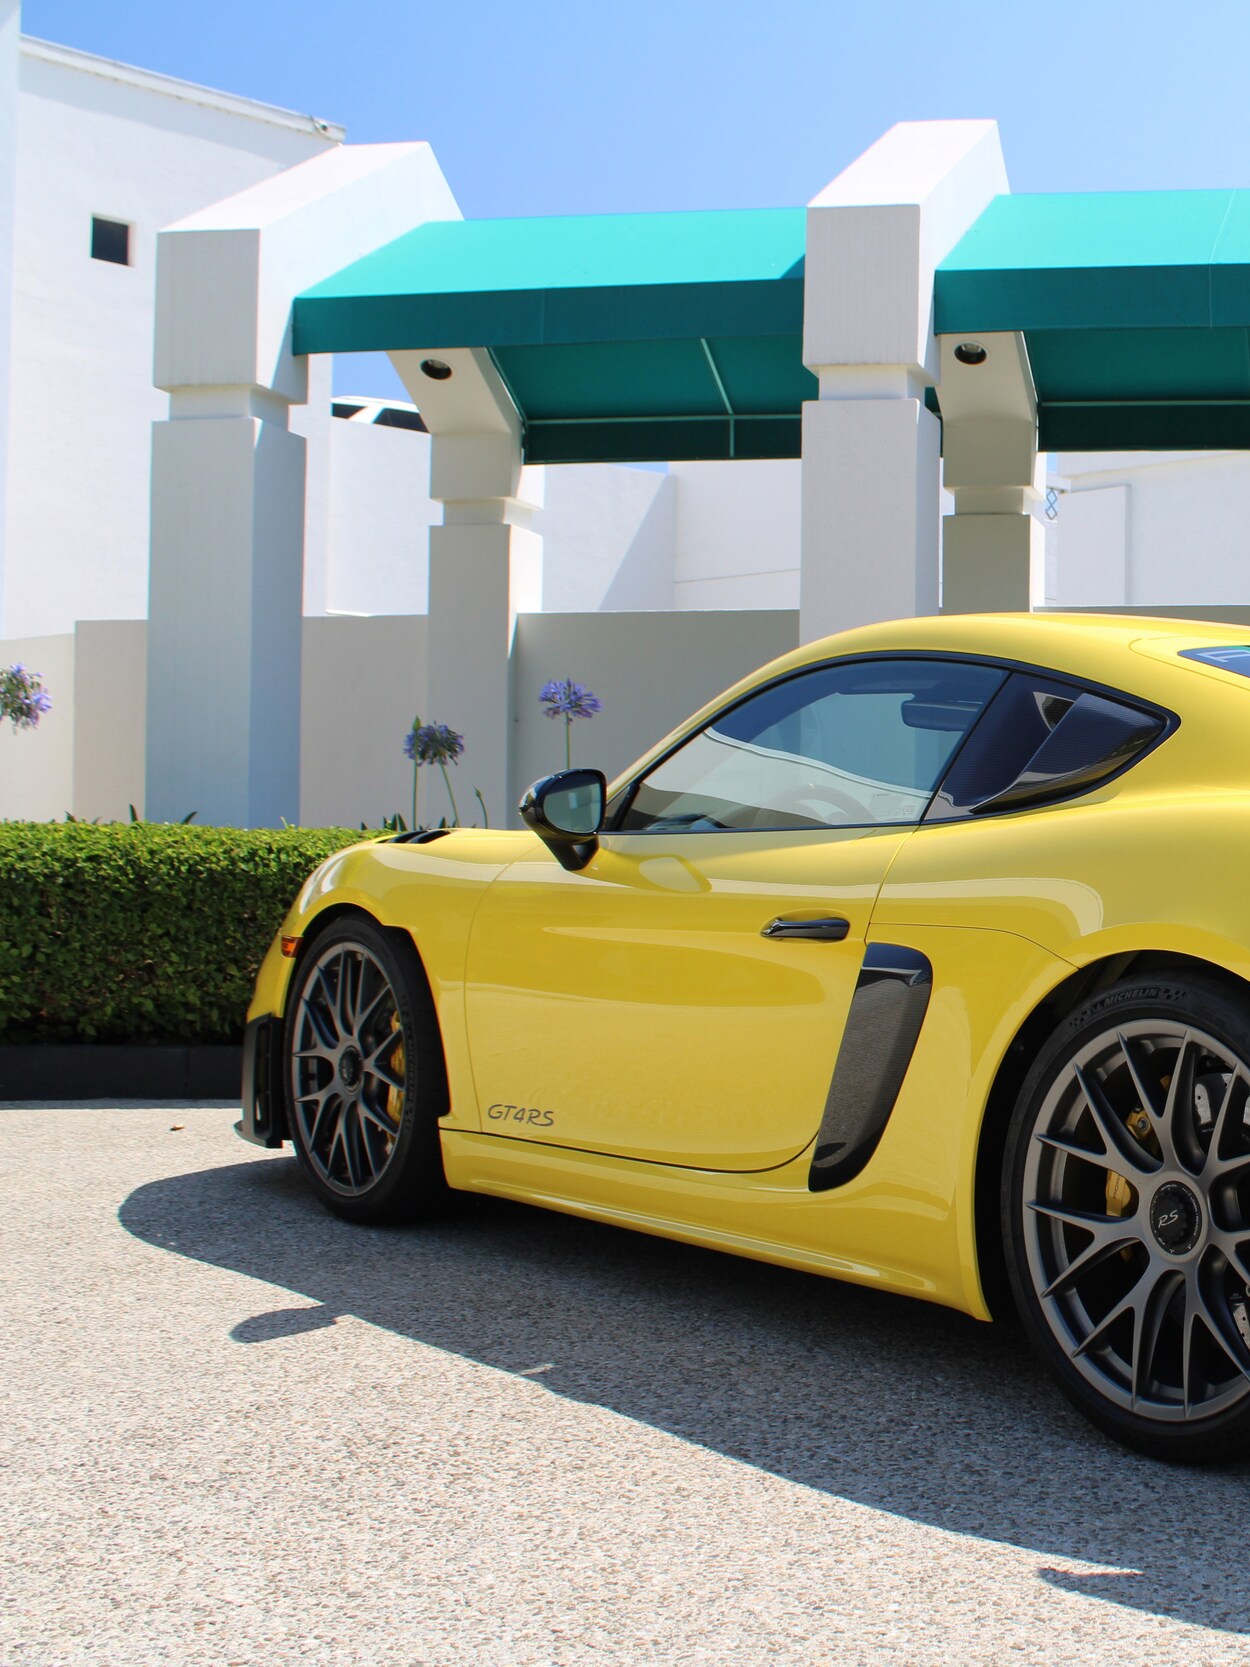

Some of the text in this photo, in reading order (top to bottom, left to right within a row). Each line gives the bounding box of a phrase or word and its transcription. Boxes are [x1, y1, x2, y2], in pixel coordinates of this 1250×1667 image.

[1103, 986, 1160, 1007] MICHELIN
[487, 1104, 554, 1127] GT4RS
[1158, 1209, 1179, 1228] RS
